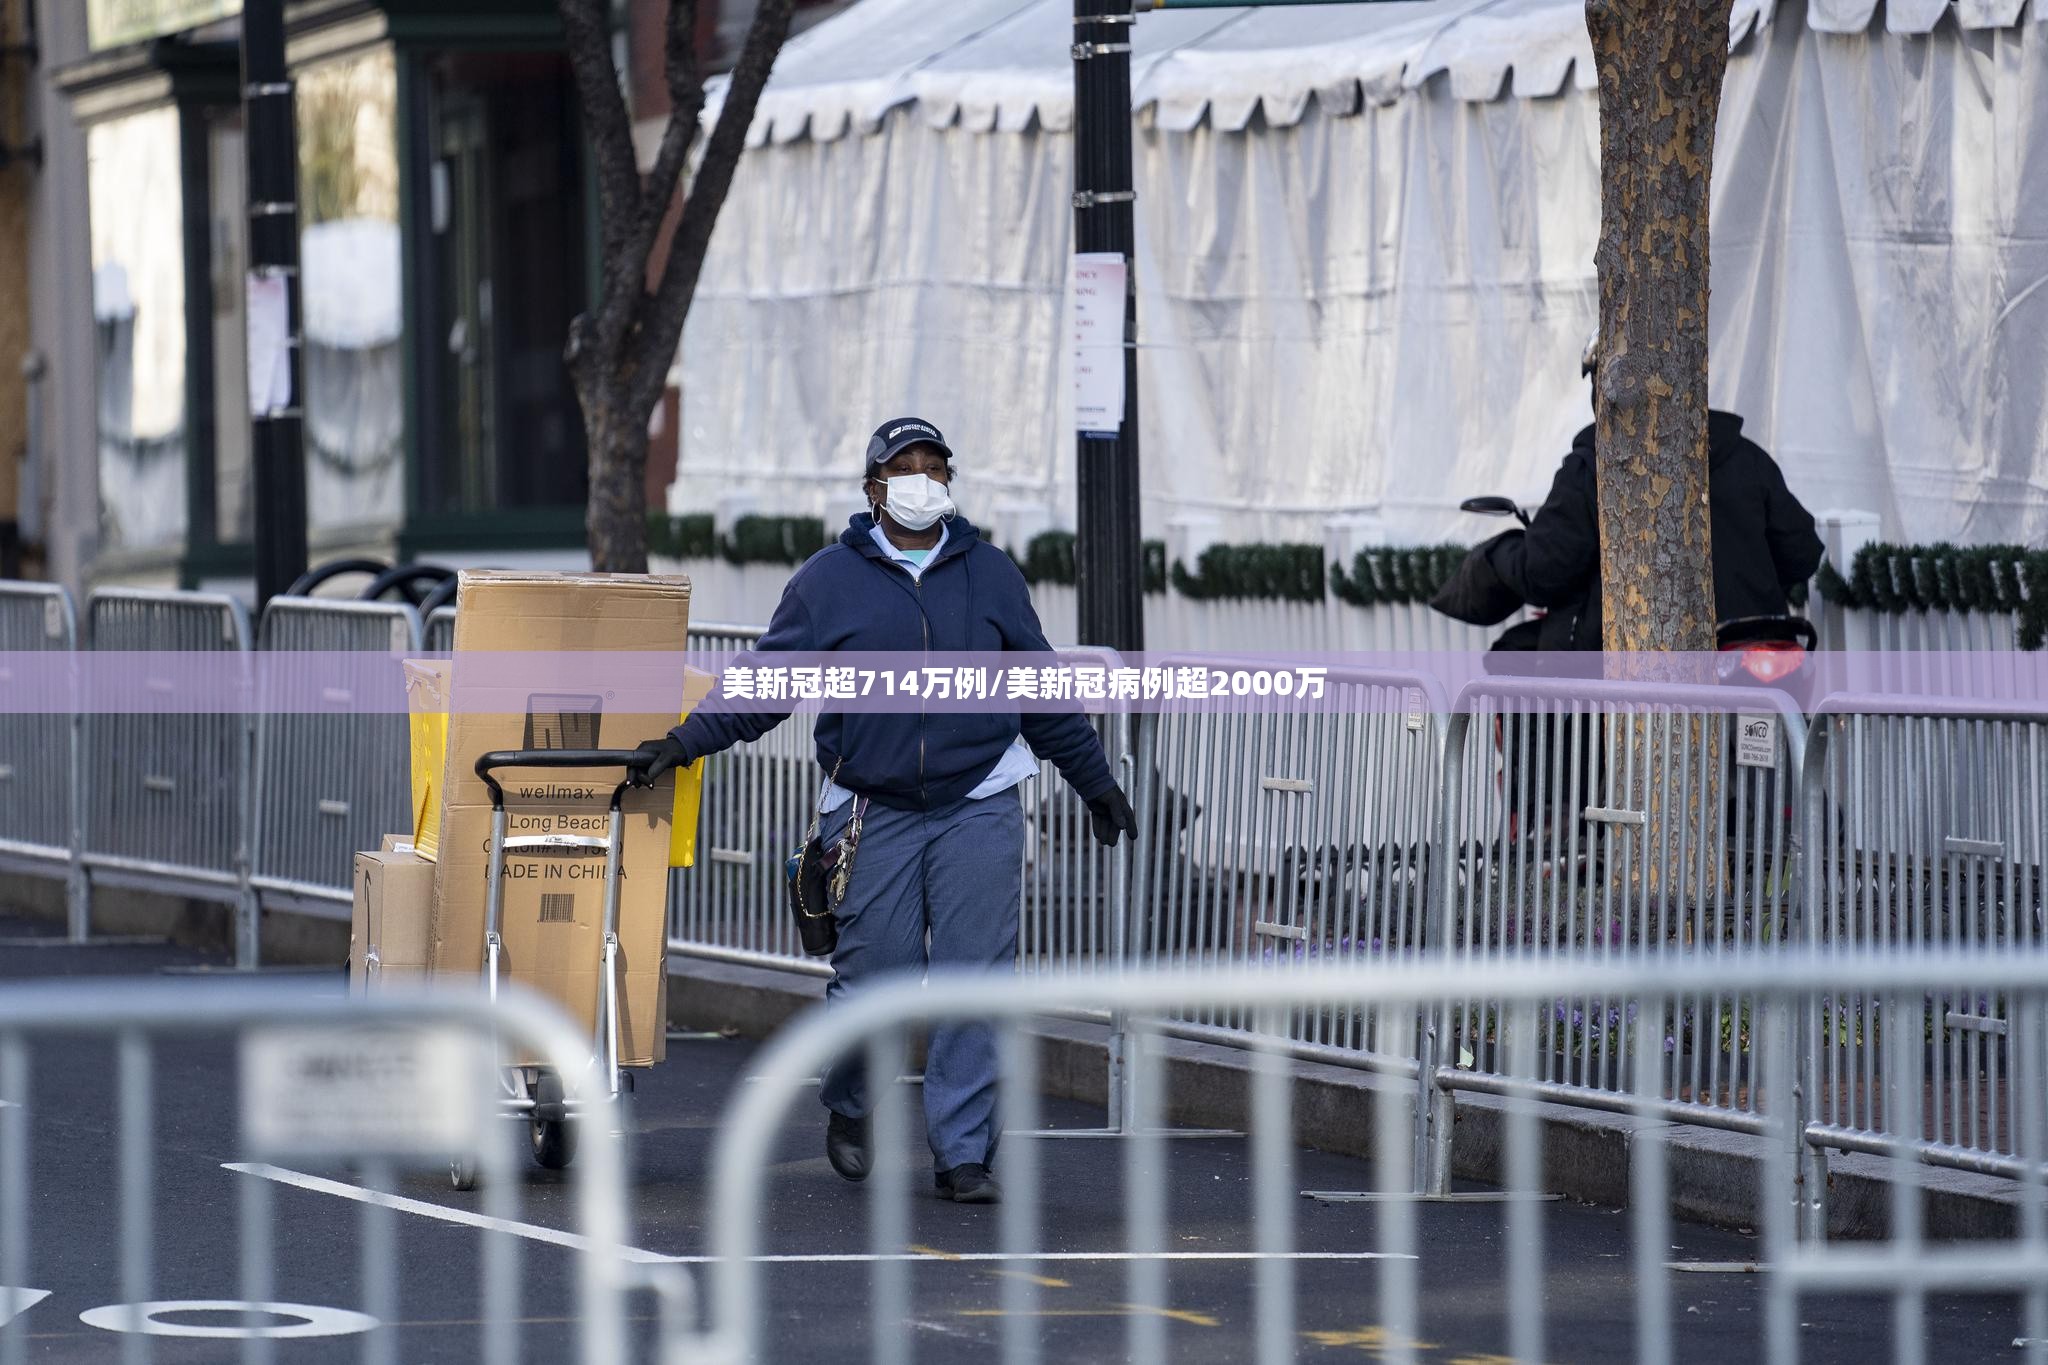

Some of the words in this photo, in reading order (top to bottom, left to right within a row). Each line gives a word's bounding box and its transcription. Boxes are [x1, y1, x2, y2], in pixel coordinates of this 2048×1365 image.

[1744, 722, 1769, 738] SONCO
[520, 784, 595, 800] wellmax
[509, 814, 551, 832] Long
[557, 814, 609, 830] Beach
[544, 864, 562, 879] IN
